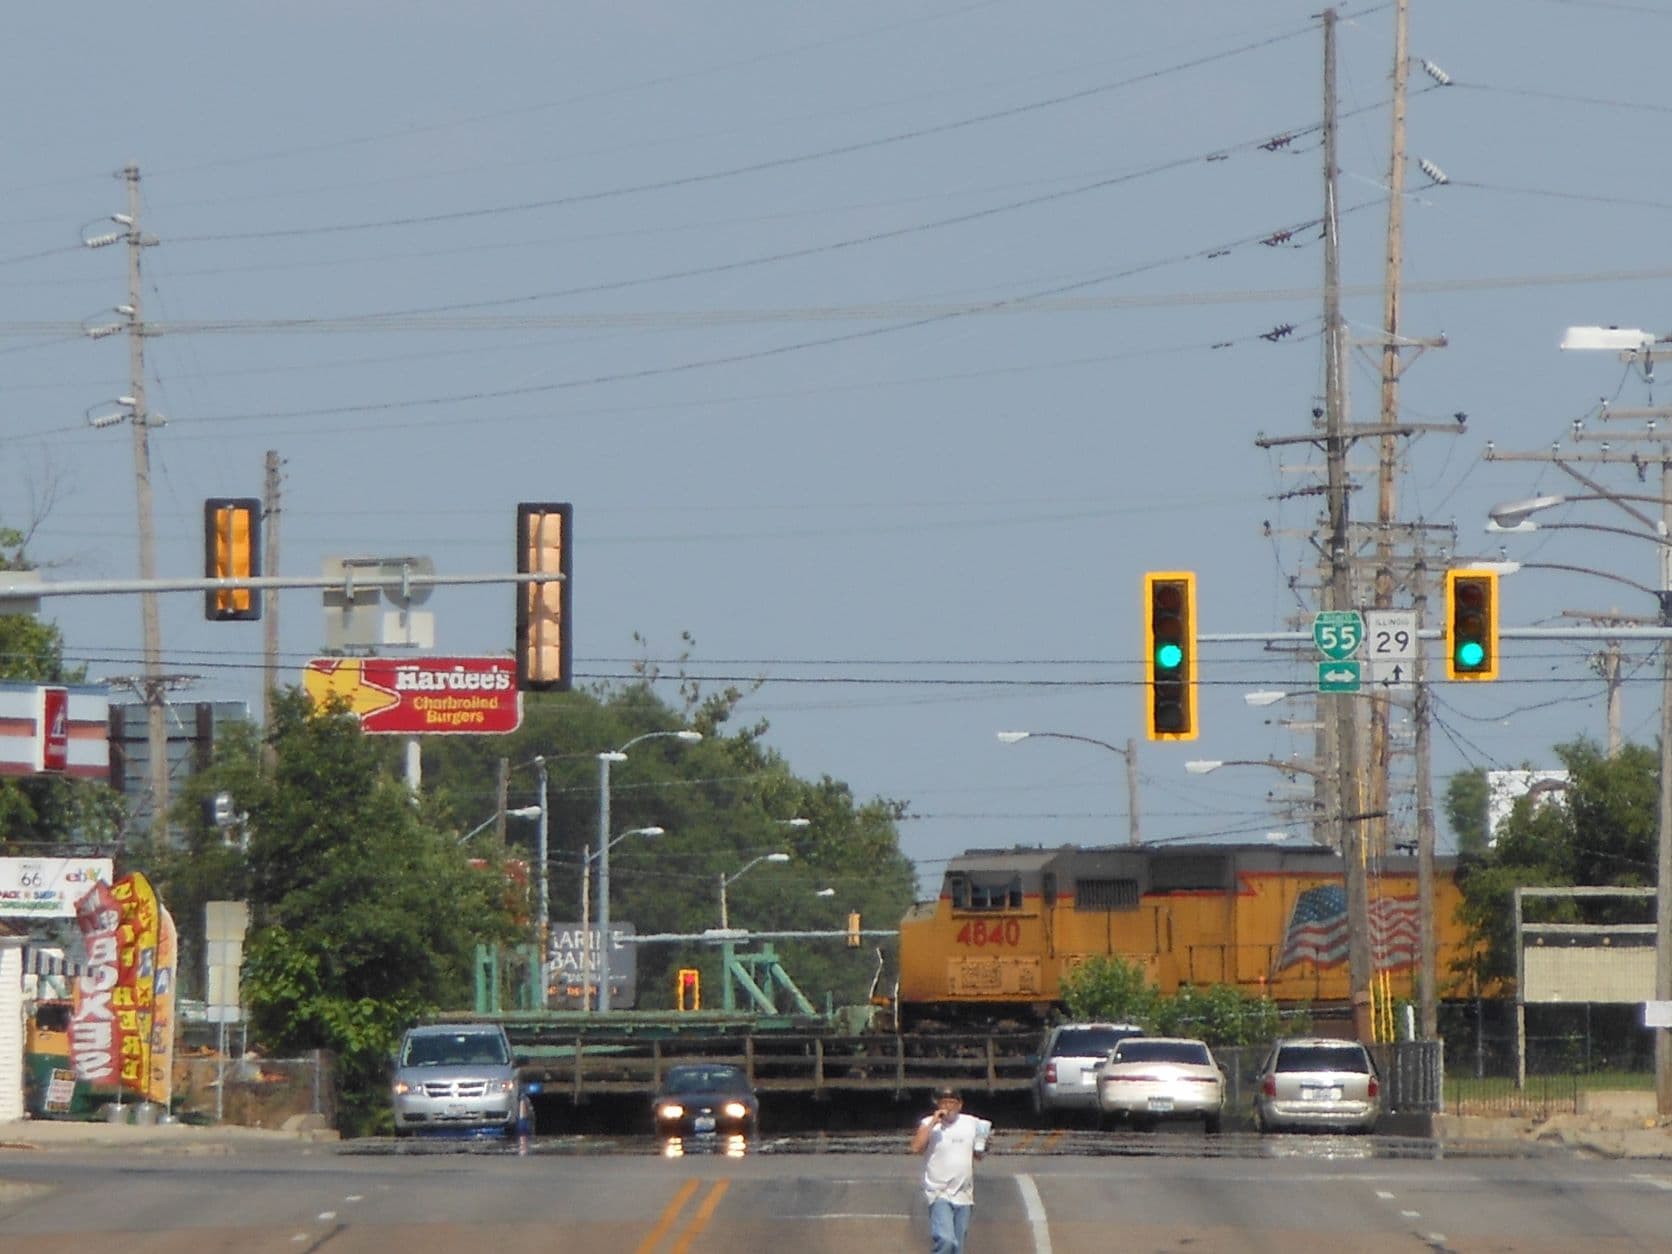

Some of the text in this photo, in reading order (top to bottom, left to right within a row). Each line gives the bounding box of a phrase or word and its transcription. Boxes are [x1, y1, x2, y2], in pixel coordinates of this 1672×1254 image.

[1321, 626, 1356, 650] 55
[1376, 630, 1409, 653] 29
[395, 665, 510, 691] Hardee's
[426, 710, 485, 725] Burgers
[21, 872, 41, 887] 66
[956, 918, 1021, 947] 4840
